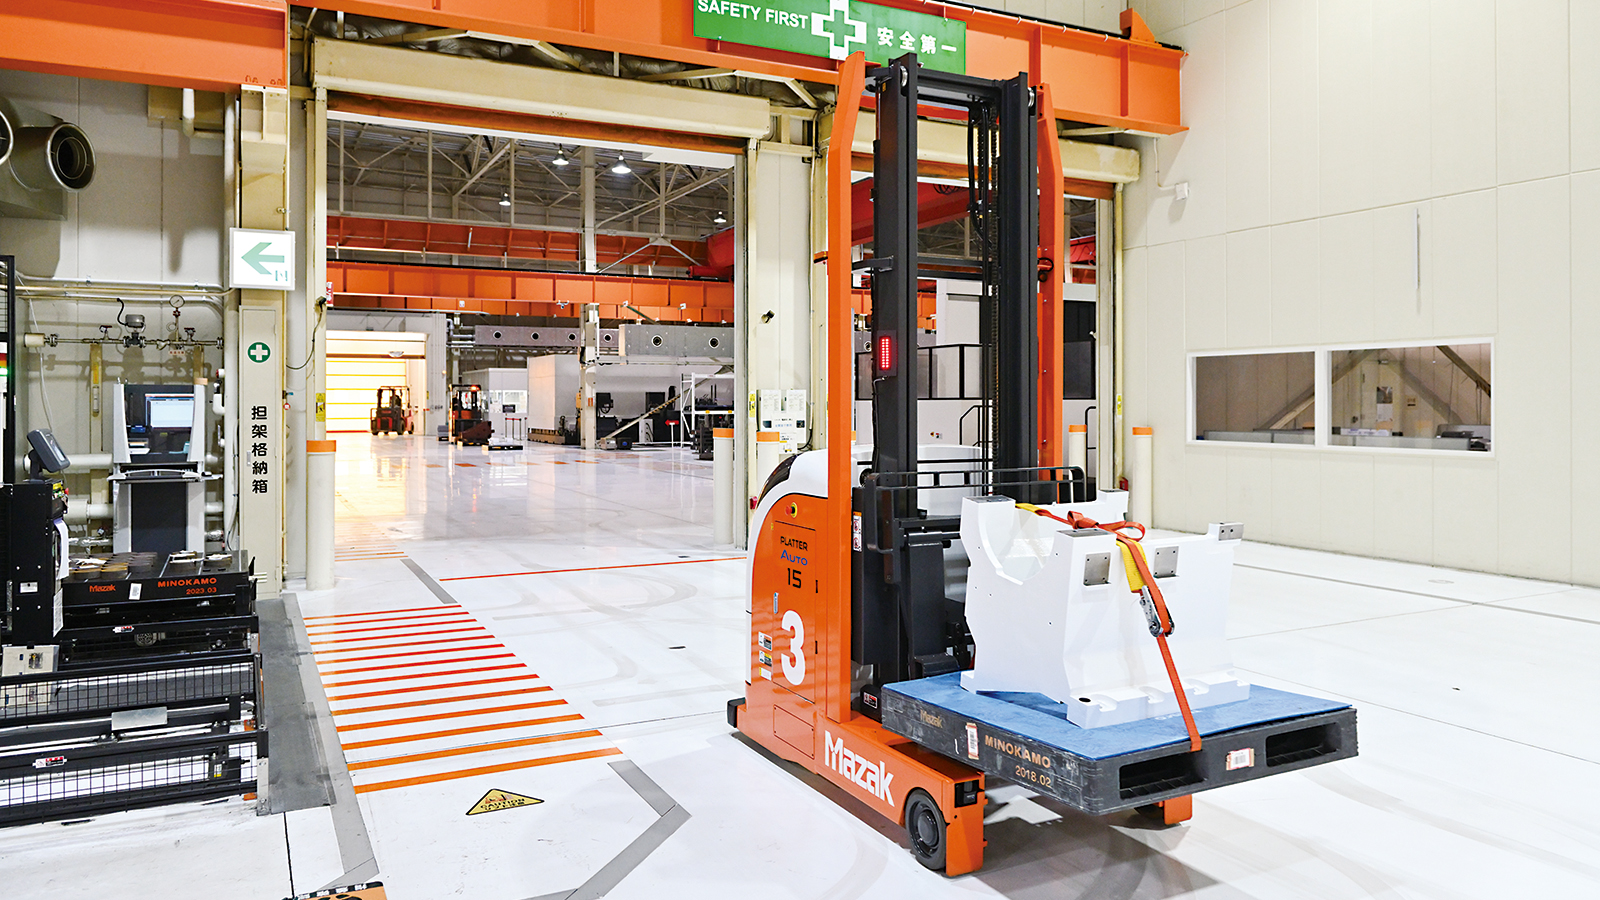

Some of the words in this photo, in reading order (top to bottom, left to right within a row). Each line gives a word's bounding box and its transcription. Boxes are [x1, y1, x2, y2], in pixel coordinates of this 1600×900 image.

[697, 0, 761, 20] SAFETY
[765, 8, 808, 29] FIRST
[877, 26, 957, 54] 安全第一
[251, 405, 268, 494] 担架格納箱
[780, 535, 808, 551] PLATTER
[89, 584, 117, 593] Mazak
[157, 577, 218, 588] MINOKAMO
[787, 567, 802, 589] 15
[781, 610, 806, 685] 3
[920, 709, 943, 728] Mazak
[985, 734, 1051, 769] MINOKAMO
[825, 730, 895, 807] Mazak
[1015, 765, 1052, 788] 2018.02
